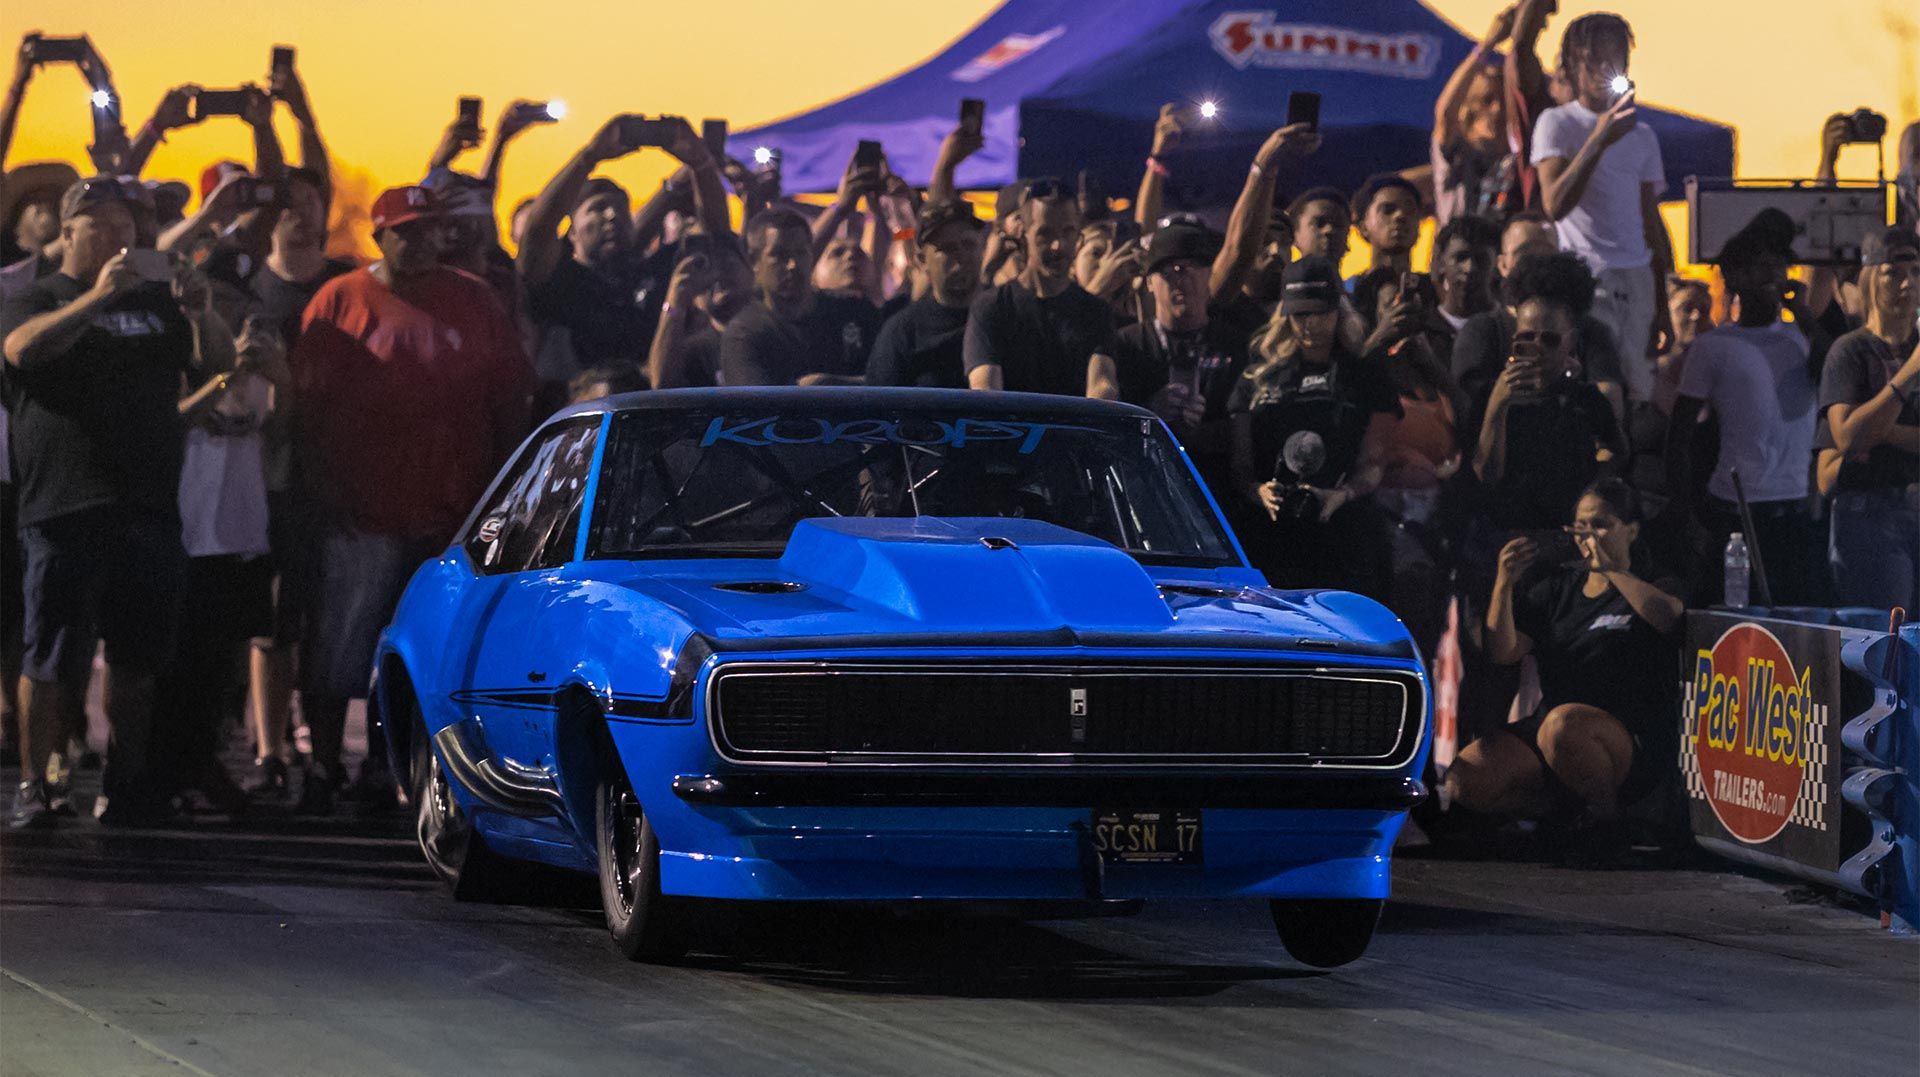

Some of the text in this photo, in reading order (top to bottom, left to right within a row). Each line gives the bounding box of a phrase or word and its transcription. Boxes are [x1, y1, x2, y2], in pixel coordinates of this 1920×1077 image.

[1692, 649, 1811, 767] Pac West
[1713, 769, 1786, 816] TRAILERS.com
[1096, 824, 1198, 851] SCSN 17
